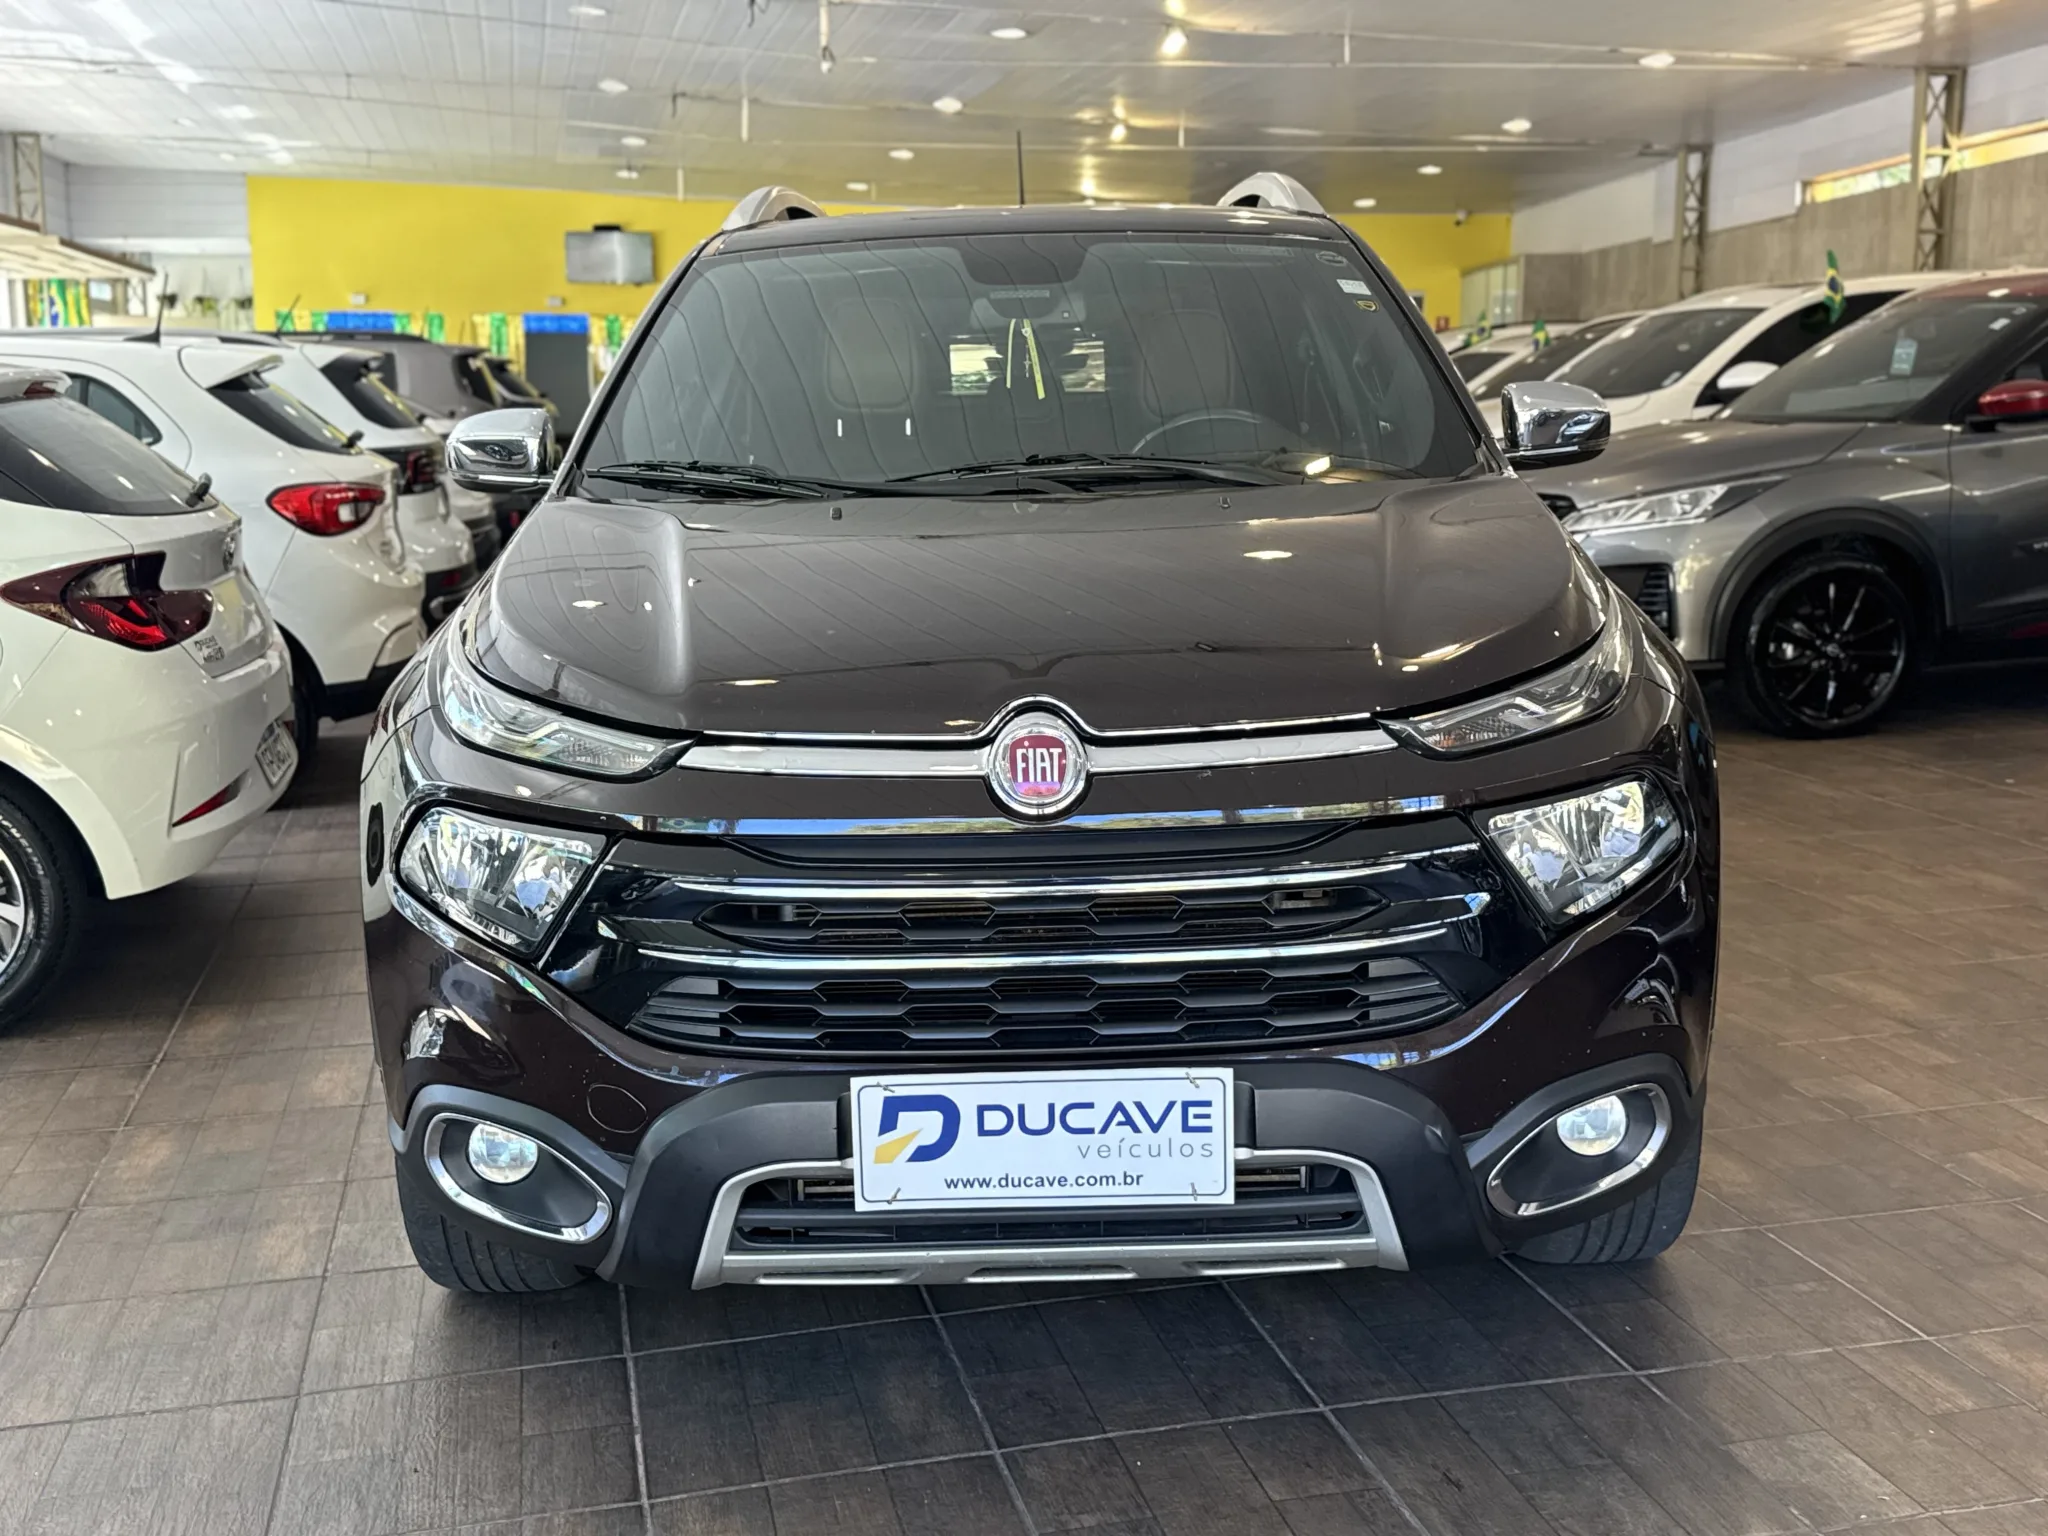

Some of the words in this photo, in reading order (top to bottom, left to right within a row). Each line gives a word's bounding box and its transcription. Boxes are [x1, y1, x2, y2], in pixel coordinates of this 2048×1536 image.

[1016, 748, 1062, 783] FIAT
[976, 1100, 1213, 1137] DUCAVE
[1077, 1137, 1213, 1159] veículos
[944, 1171, 1144, 1190] www.ducave.com.br
